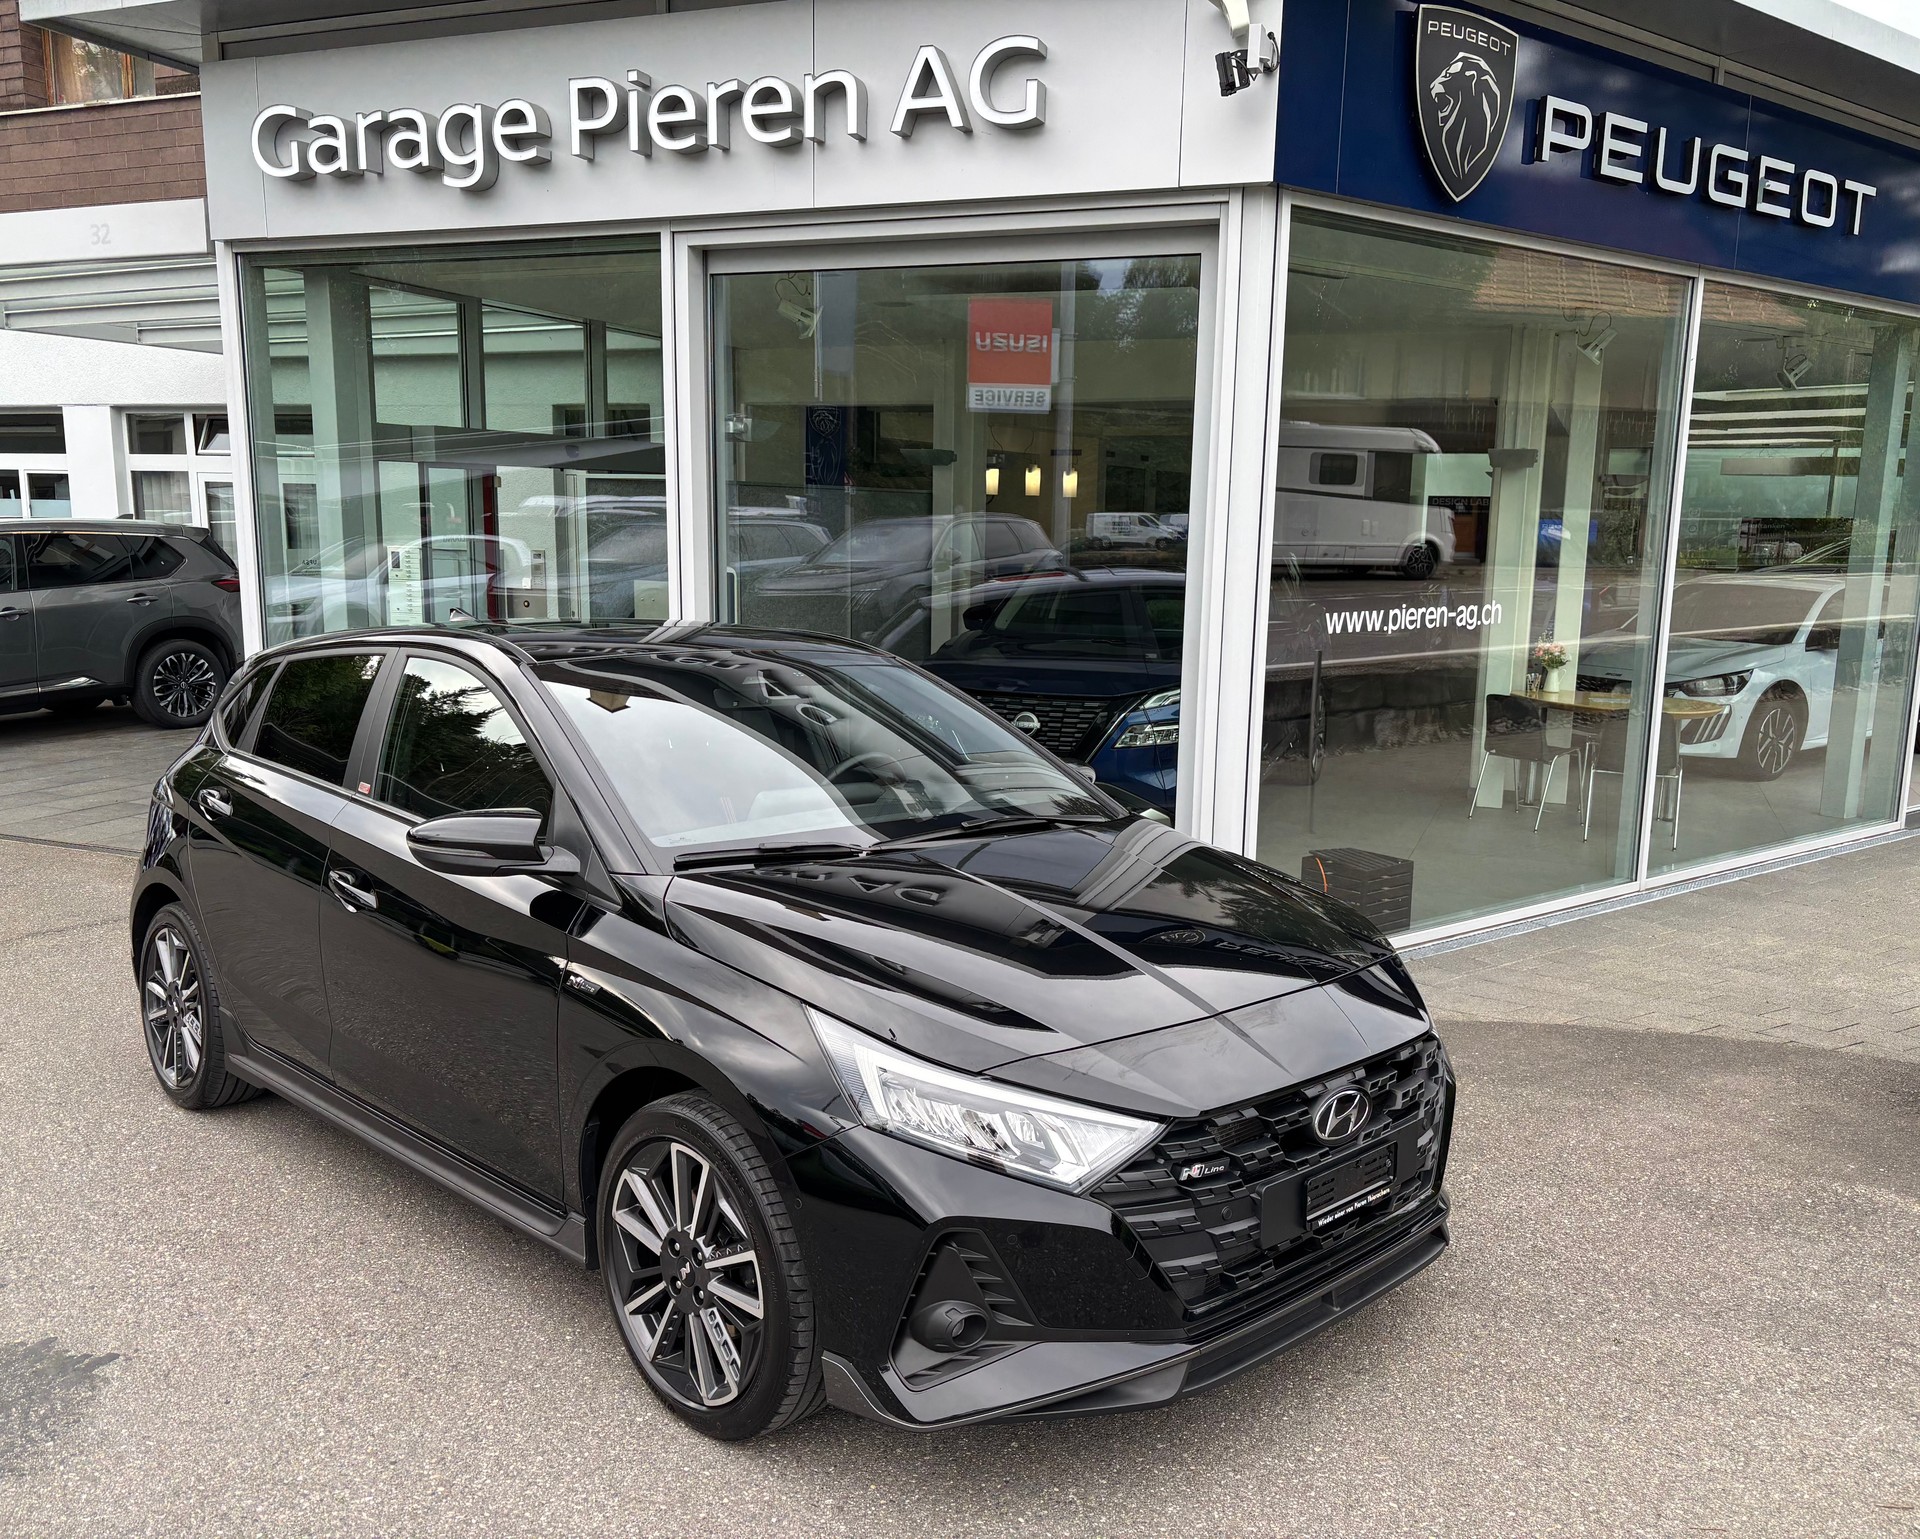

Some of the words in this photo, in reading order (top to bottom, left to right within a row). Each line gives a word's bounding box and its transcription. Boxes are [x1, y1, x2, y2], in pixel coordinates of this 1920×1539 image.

[1427, 20, 1512, 56] PEUGEOT
[250, 97, 551, 191] Garage
[568, 69, 868, 160] Pieren
[890, 35, 1047, 138] AG
[1540, 95, 1877, 236] PEUGEOT
[90, 223, 111, 245] 32
[1432, 497, 1468, 506] DESIGN
[1471, 498, 1490, 506] LAB
[1325, 600, 1502, 634] www.pieren-ag.ch
[1204, 1165, 1225, 1175] Line
[1317, 1215, 1334, 1227] Wieder
[1346, 1205, 1354, 1214] von
[1354, 1199, 1367, 1210] Pieren
